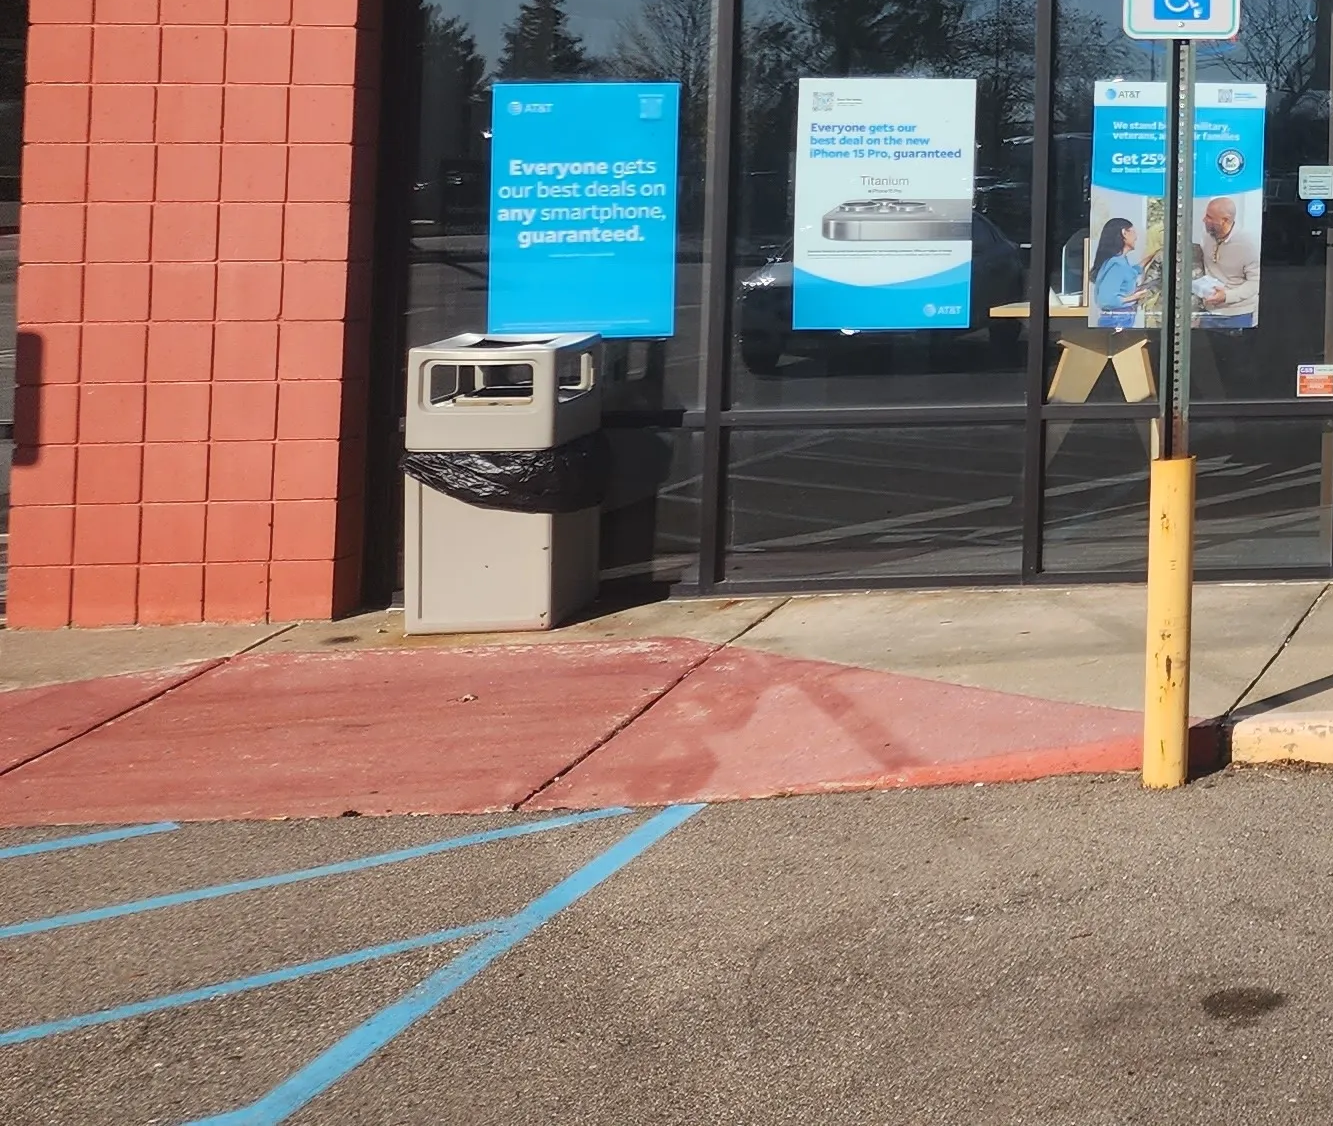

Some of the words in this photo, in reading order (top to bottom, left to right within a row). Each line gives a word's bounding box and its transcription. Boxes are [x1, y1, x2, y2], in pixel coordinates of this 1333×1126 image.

[1118, 90, 1141, 98] AT&T
[810, 123, 867, 135] Everyone
[868, 123, 895, 135] gets
[897, 124, 917, 133] our
[1112, 121, 1129, 130] We
[1129, 121, 1157, 130] stand
[810, 136, 836, 145] best
[839, 135, 864, 145] deal
[866, 137, 881, 145] on
[883, 135, 903, 145] the
[905, 137, 930, 145] new
[1202, 131, 1240, 141] families
[809, 149, 850, 159] iPhone
[853, 149, 864, 159] 15
[867, 149, 891, 160] Pro,
[893, 148, 962, 160] guaranteed
[1111, 153, 1139, 165] Get
[509, 159, 608, 179] Everyone
[612, 158, 657, 179] gets
[860, 175, 909, 186] Titanium
[498, 185, 533, 199] our
[536, 181, 581, 198] best
[584, 180, 636, 197] deals
[640, 183, 666, 197] on
[497, 207, 536, 225] any
[540, 203, 667, 223] smartphone,
[517, 225, 645, 249] guaranteed.
[937, 305, 962, 315] AT&T
